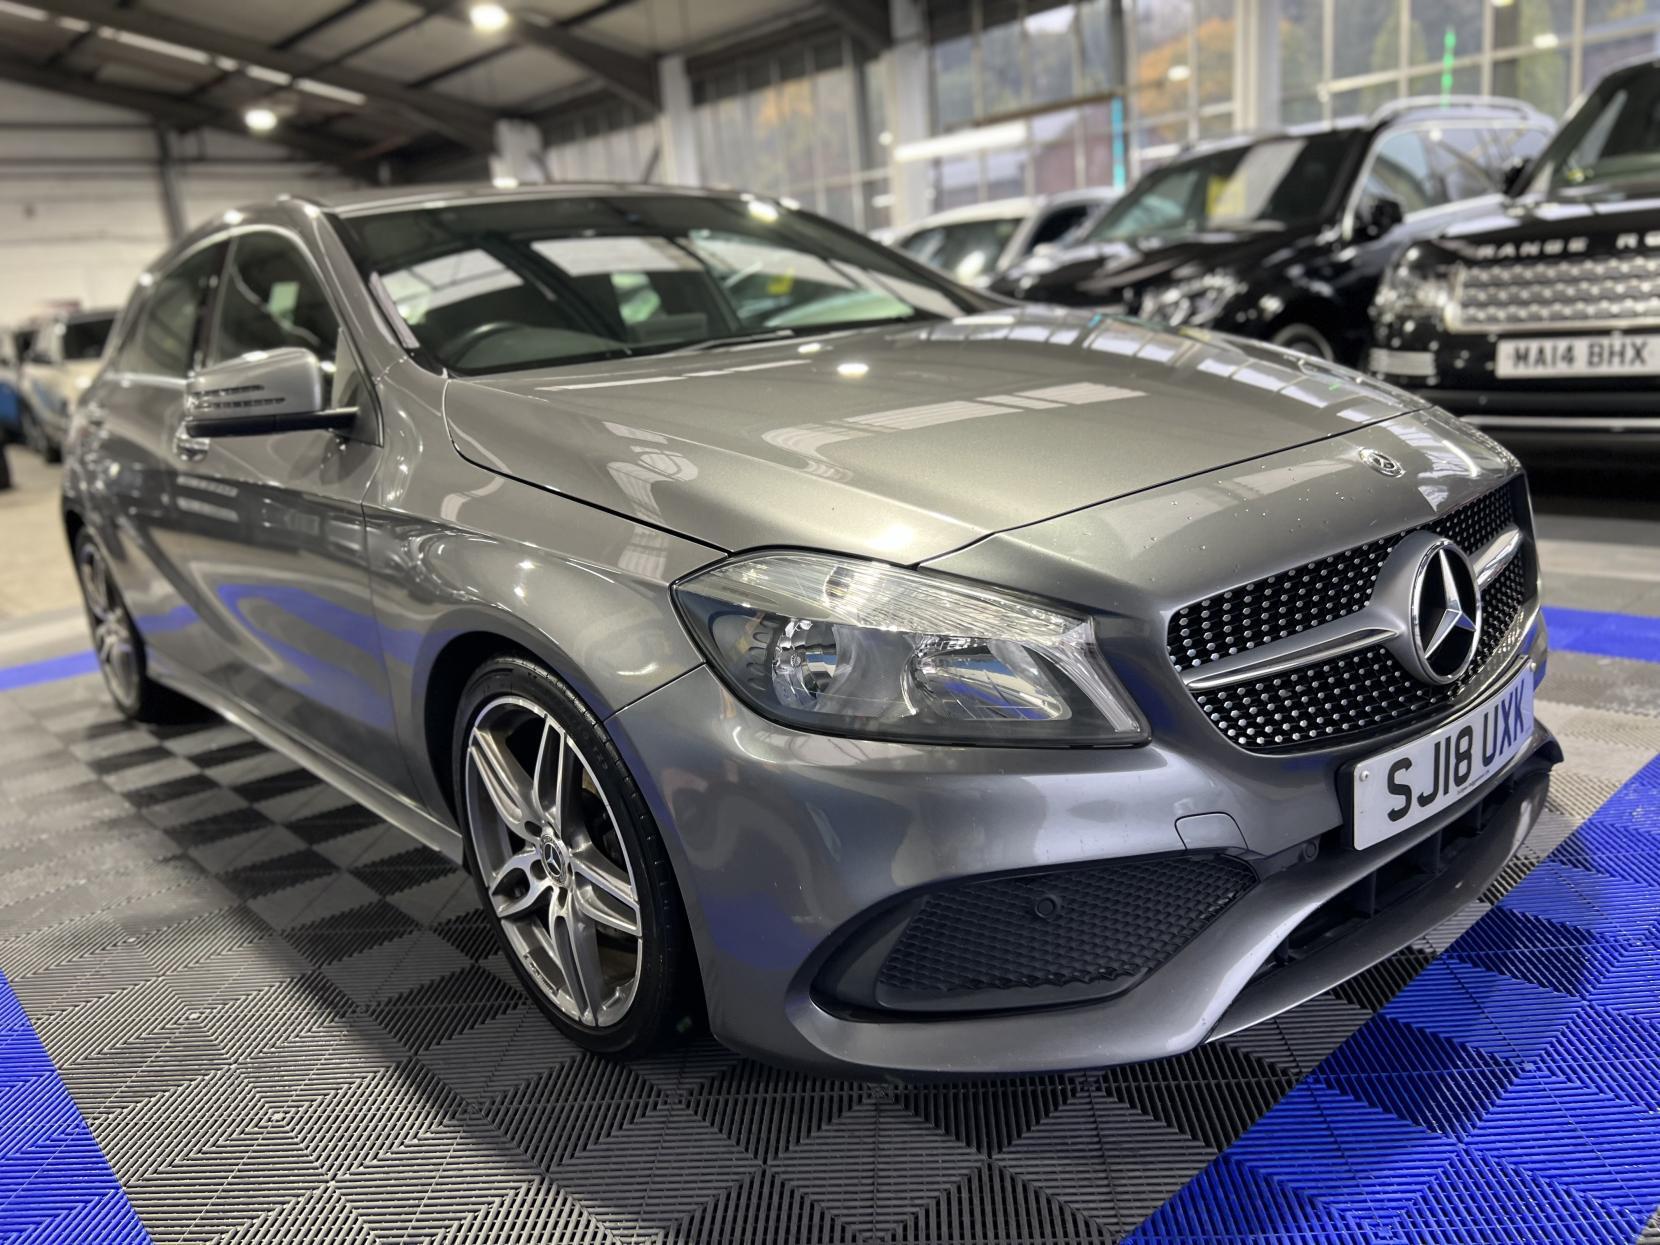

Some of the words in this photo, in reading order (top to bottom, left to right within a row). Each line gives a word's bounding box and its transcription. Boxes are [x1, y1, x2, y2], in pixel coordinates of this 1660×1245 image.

[1476, 236, 1588, 258] RANGE
[1587, 341, 1648, 367] BHX
[1388, 725, 1473, 822] SJ18
[1482, 679, 1525, 767] UXK
